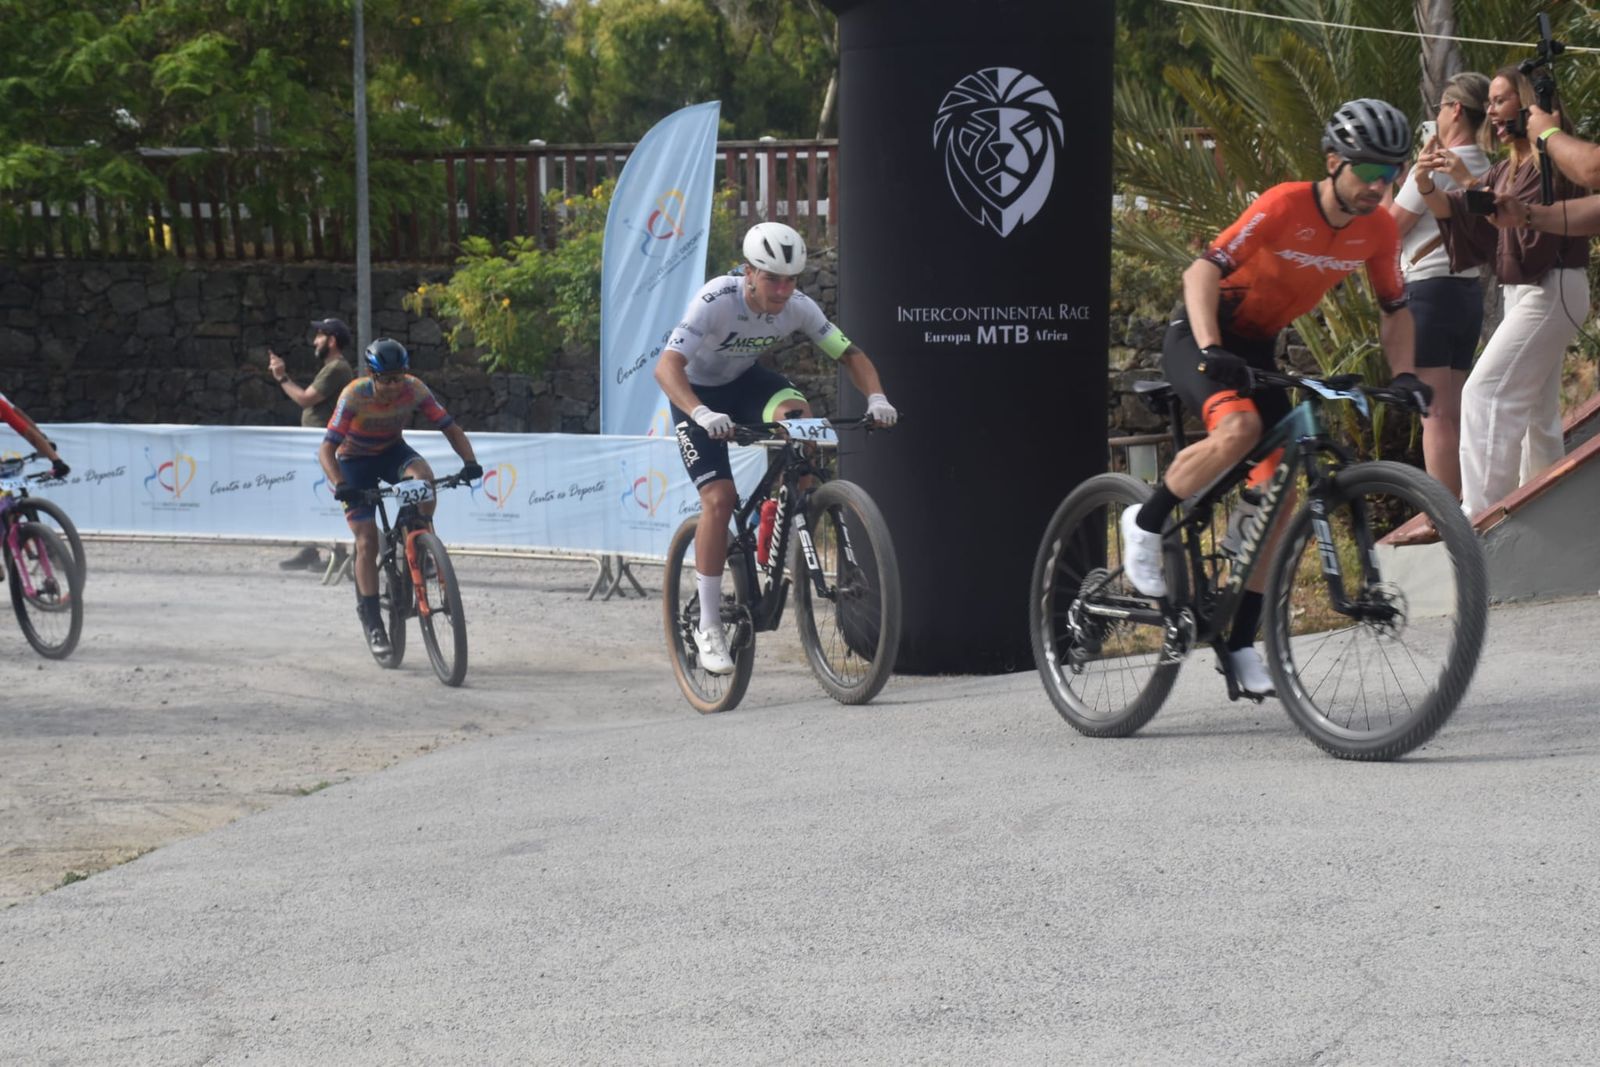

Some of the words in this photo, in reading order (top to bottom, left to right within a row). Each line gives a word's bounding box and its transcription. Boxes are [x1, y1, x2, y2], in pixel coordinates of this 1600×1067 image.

[898, 305, 1055, 322] INTERCONTINENTAL
[1059, 303, 1090, 320] RACE
[734, 334, 779, 349] MECO
[924, 331, 971, 345] Europa
[977, 324, 1030, 344] MTB
[1035, 330, 1068, 341] Africa
[797, 424, 828, 439] 147
[85, 465, 126, 485] Deporte
[210, 481, 239, 495] Ceuta
[255, 470, 296, 490] Deporte
[402, 487, 428, 503] 232
[529, 490, 554, 505] Ceuta
[557, 491, 566, 499] es
[568, 481, 605, 501] Deporte
[799, 529, 820, 571] SID
